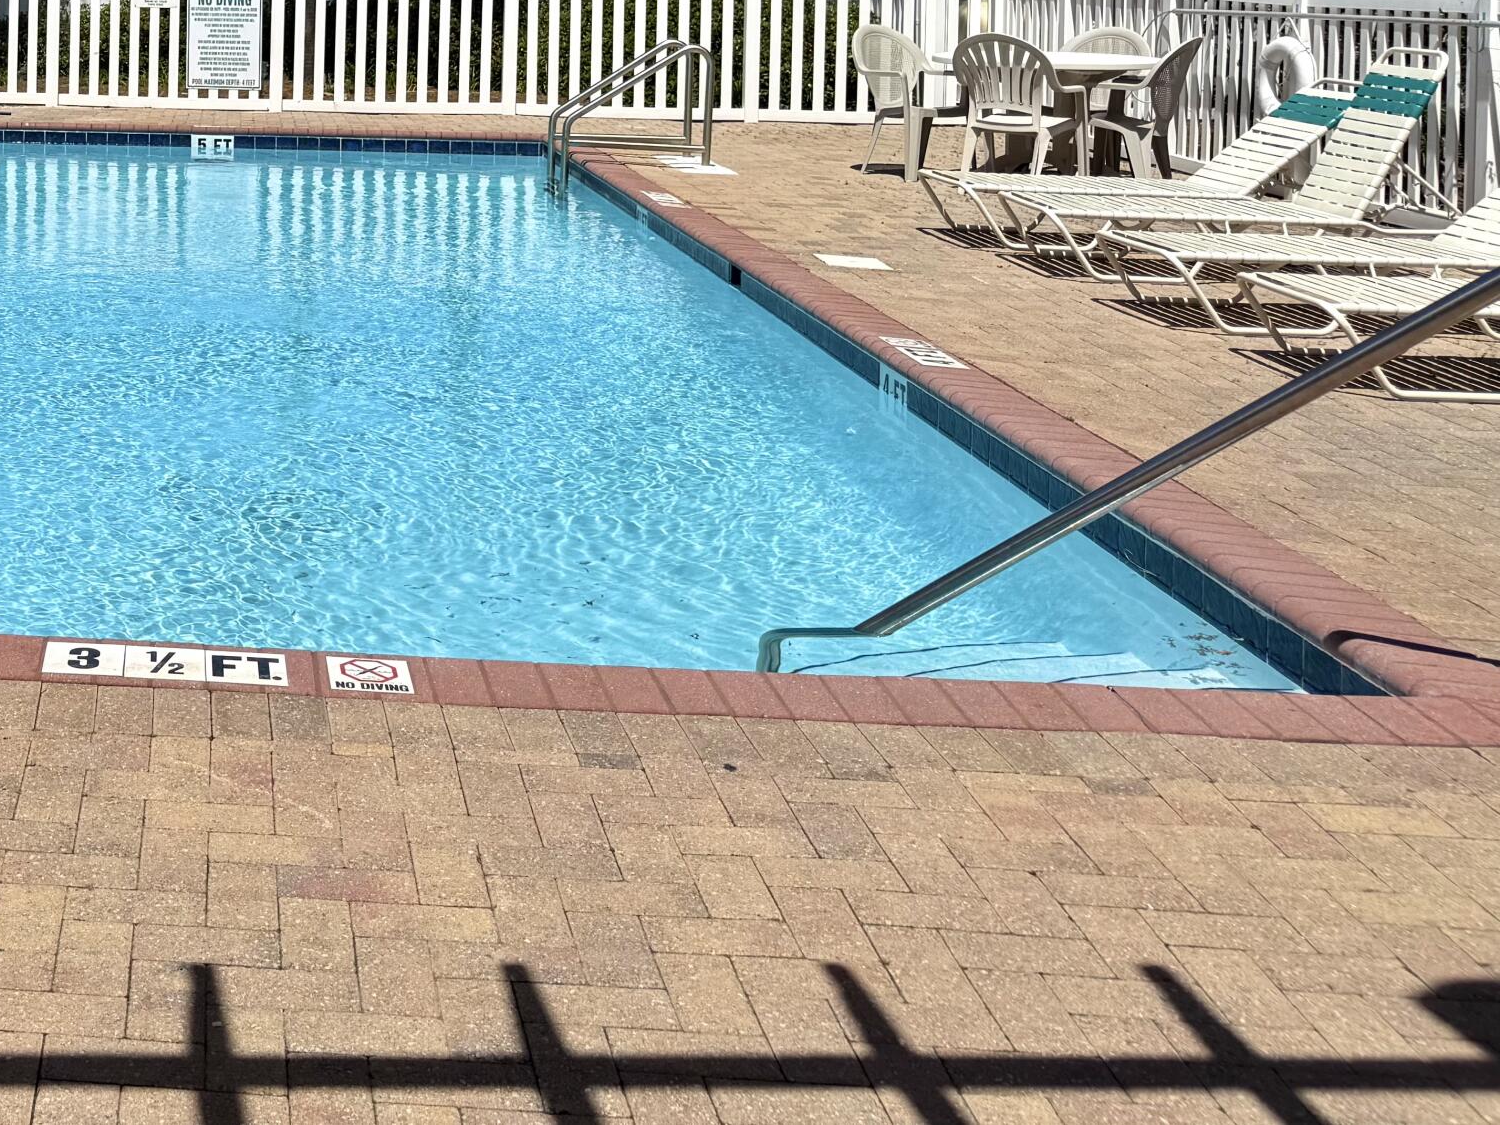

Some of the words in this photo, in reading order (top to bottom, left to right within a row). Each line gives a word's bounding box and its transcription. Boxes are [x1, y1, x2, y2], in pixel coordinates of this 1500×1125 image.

[214, 139, 231, 150] FT
[67, 647, 100, 669] 3
[211, 654, 283, 681] FT.
[335, 681, 355, 690] NO
[360, 682, 409, 692] DIVING
